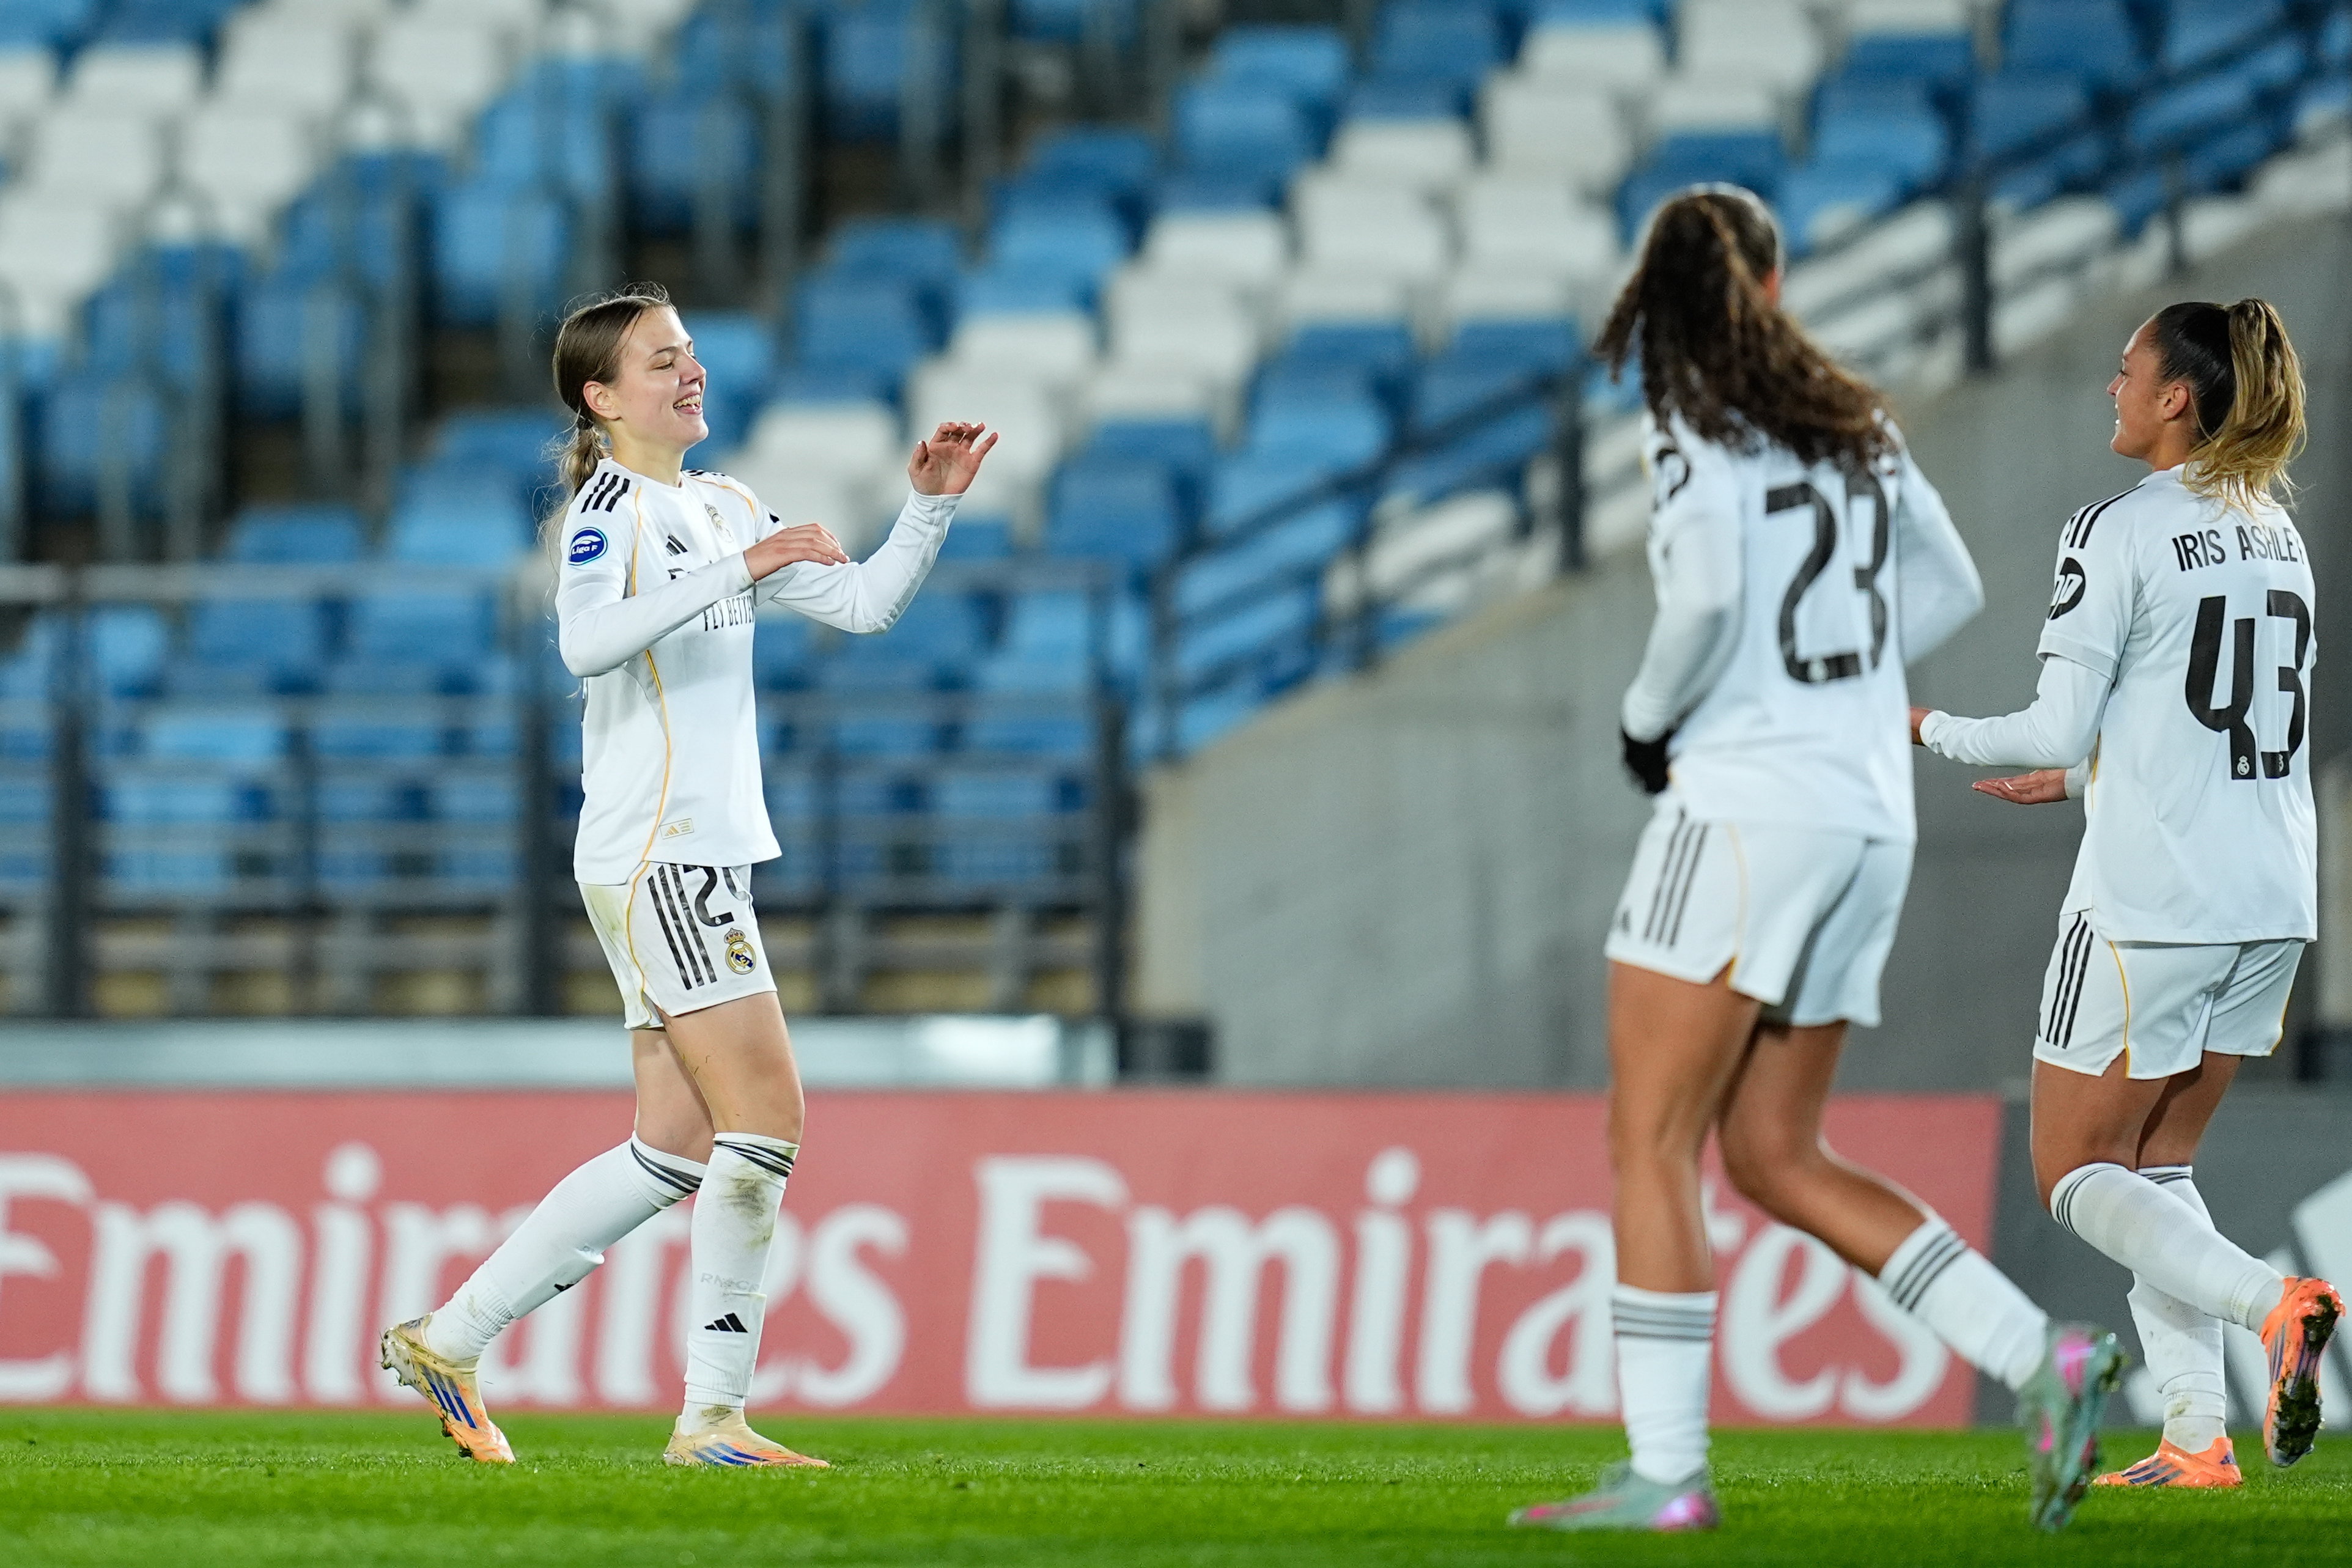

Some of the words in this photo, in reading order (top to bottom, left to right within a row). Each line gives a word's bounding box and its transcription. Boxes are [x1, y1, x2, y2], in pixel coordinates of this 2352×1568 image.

[572, 545, 591, 555] Liga
[2172, 529, 2226, 572] IRIS
[1765, 463, 1888, 682] 23
[704, 602, 724, 632] FLY
[2185, 589, 2311, 780] 43
